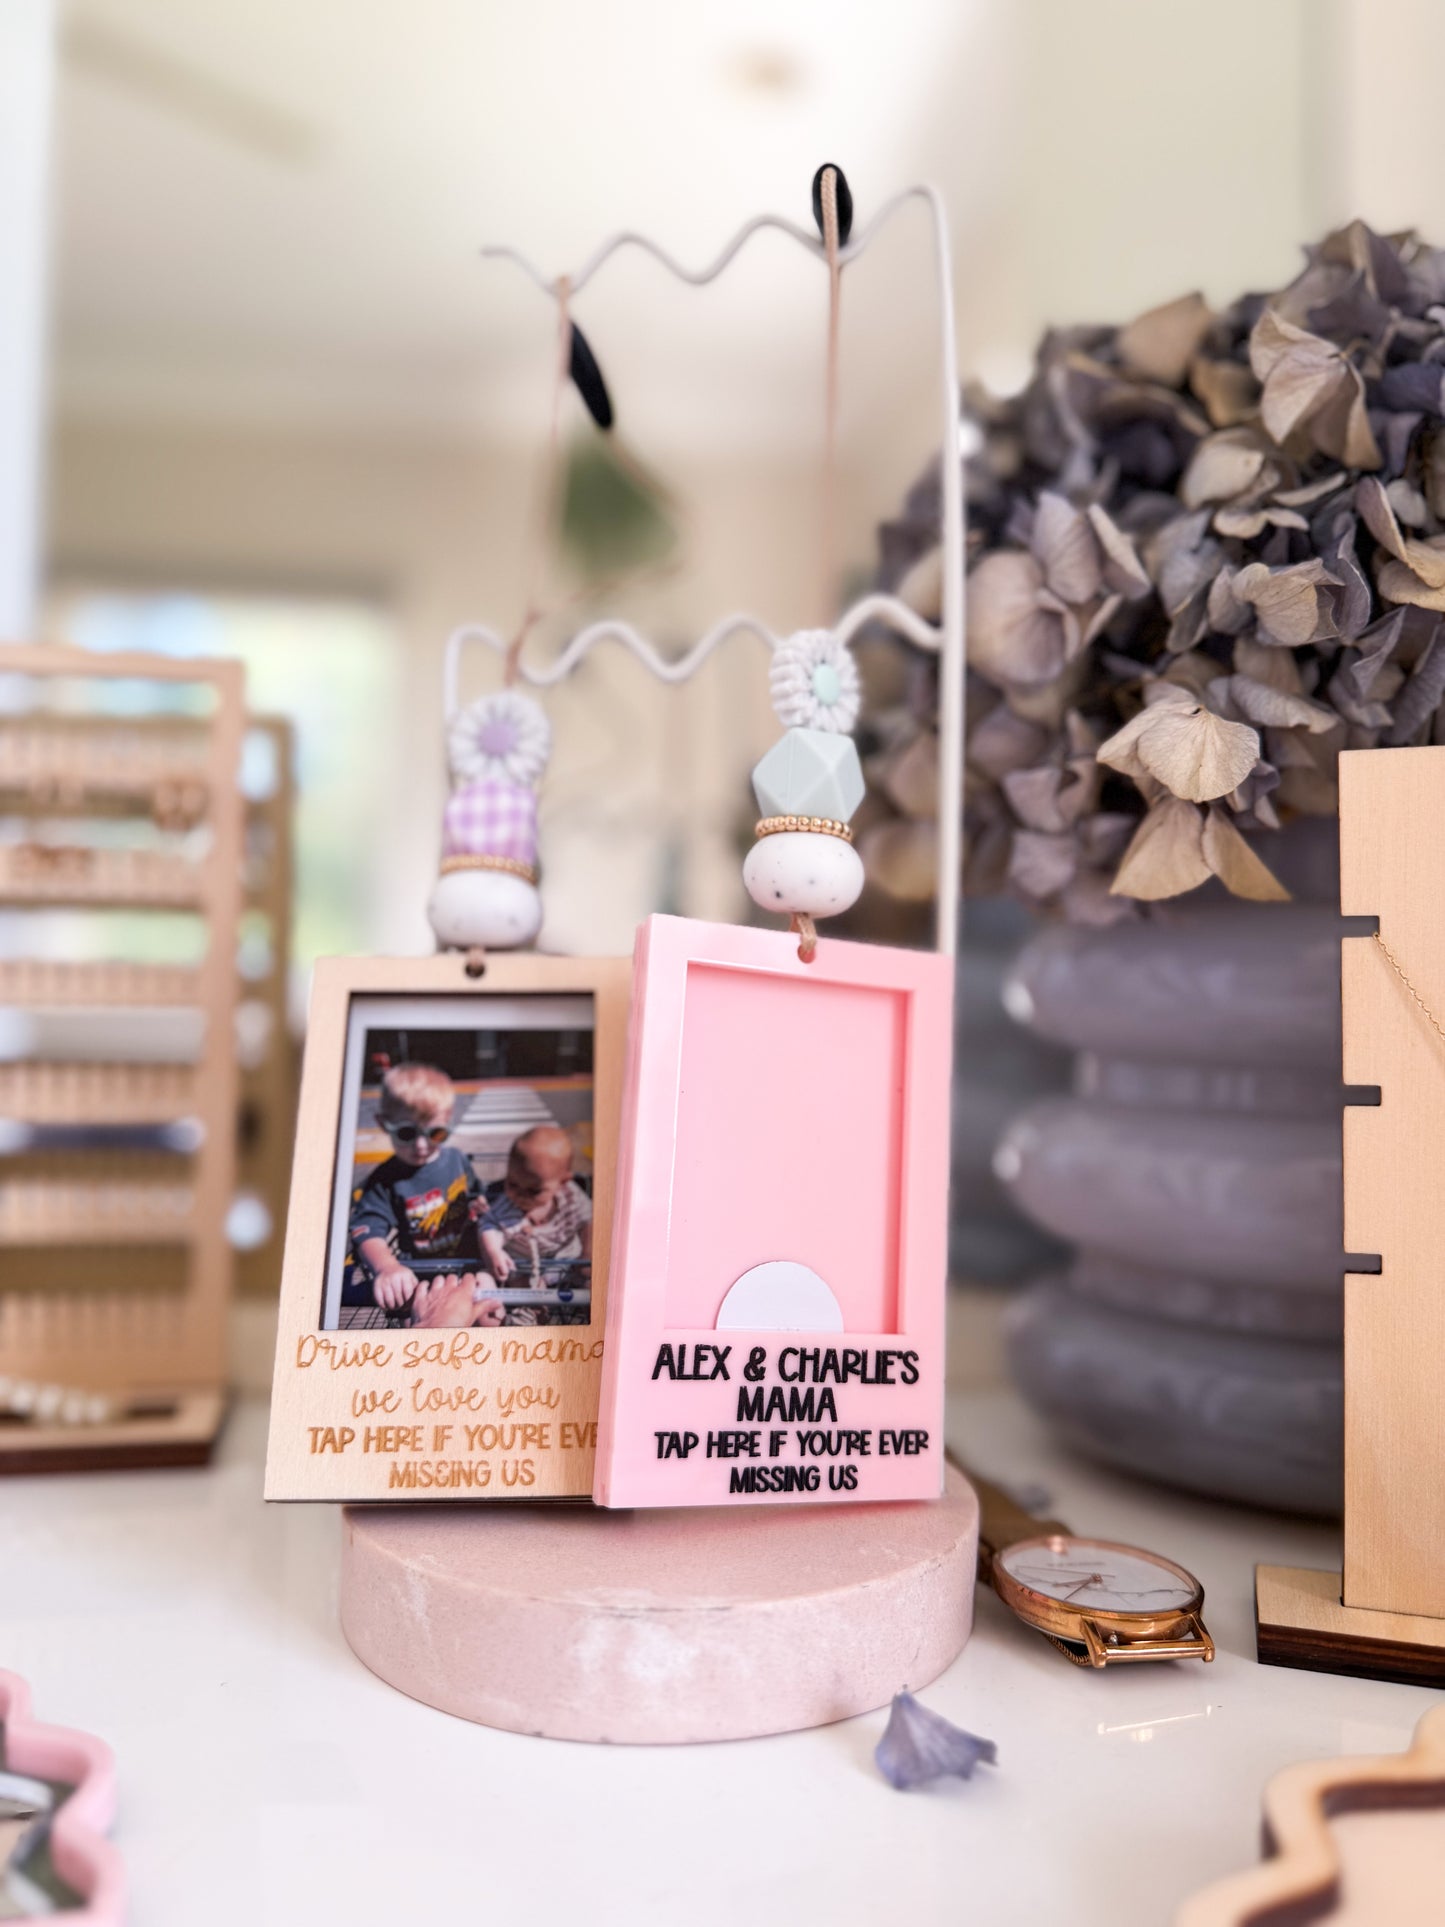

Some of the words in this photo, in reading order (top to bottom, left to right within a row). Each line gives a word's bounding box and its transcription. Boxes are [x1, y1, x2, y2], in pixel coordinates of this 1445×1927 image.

[297, 1334, 393, 1371] Drive
[402, 1331, 491, 1370] safe
[501, 1338, 604, 1364] mama
[651, 1343, 732, 1380] ALEX
[743, 1346, 766, 1382] &
[778, 1347, 920, 1385] CHARLIE'S
[352, 1389, 403, 1417] we
[410, 1378, 487, 1413] love
[497, 1383, 561, 1418] you
[737, 1386, 838, 1422] MAMA
[307, 1426, 355, 1454] TAP
[363, 1425, 423, 1453] HERE
[432, 1424, 453, 1451] IF
[463, 1423, 551, 1450] YOU'RE
[559, 1421, 598, 1449] EVE
[655, 1431, 699, 1459] TAP
[706, 1431, 761, 1458] HERE
[769, 1430, 787, 1457] IF
[796, 1430, 871, 1457] YOU'RE
[879, 1429, 929, 1456] EVER
[389, 1459, 491, 1489] MISSING
[501, 1458, 536, 1486] US
[729, 1466, 821, 1493] MISSING
[829, 1464, 858, 1491] US
